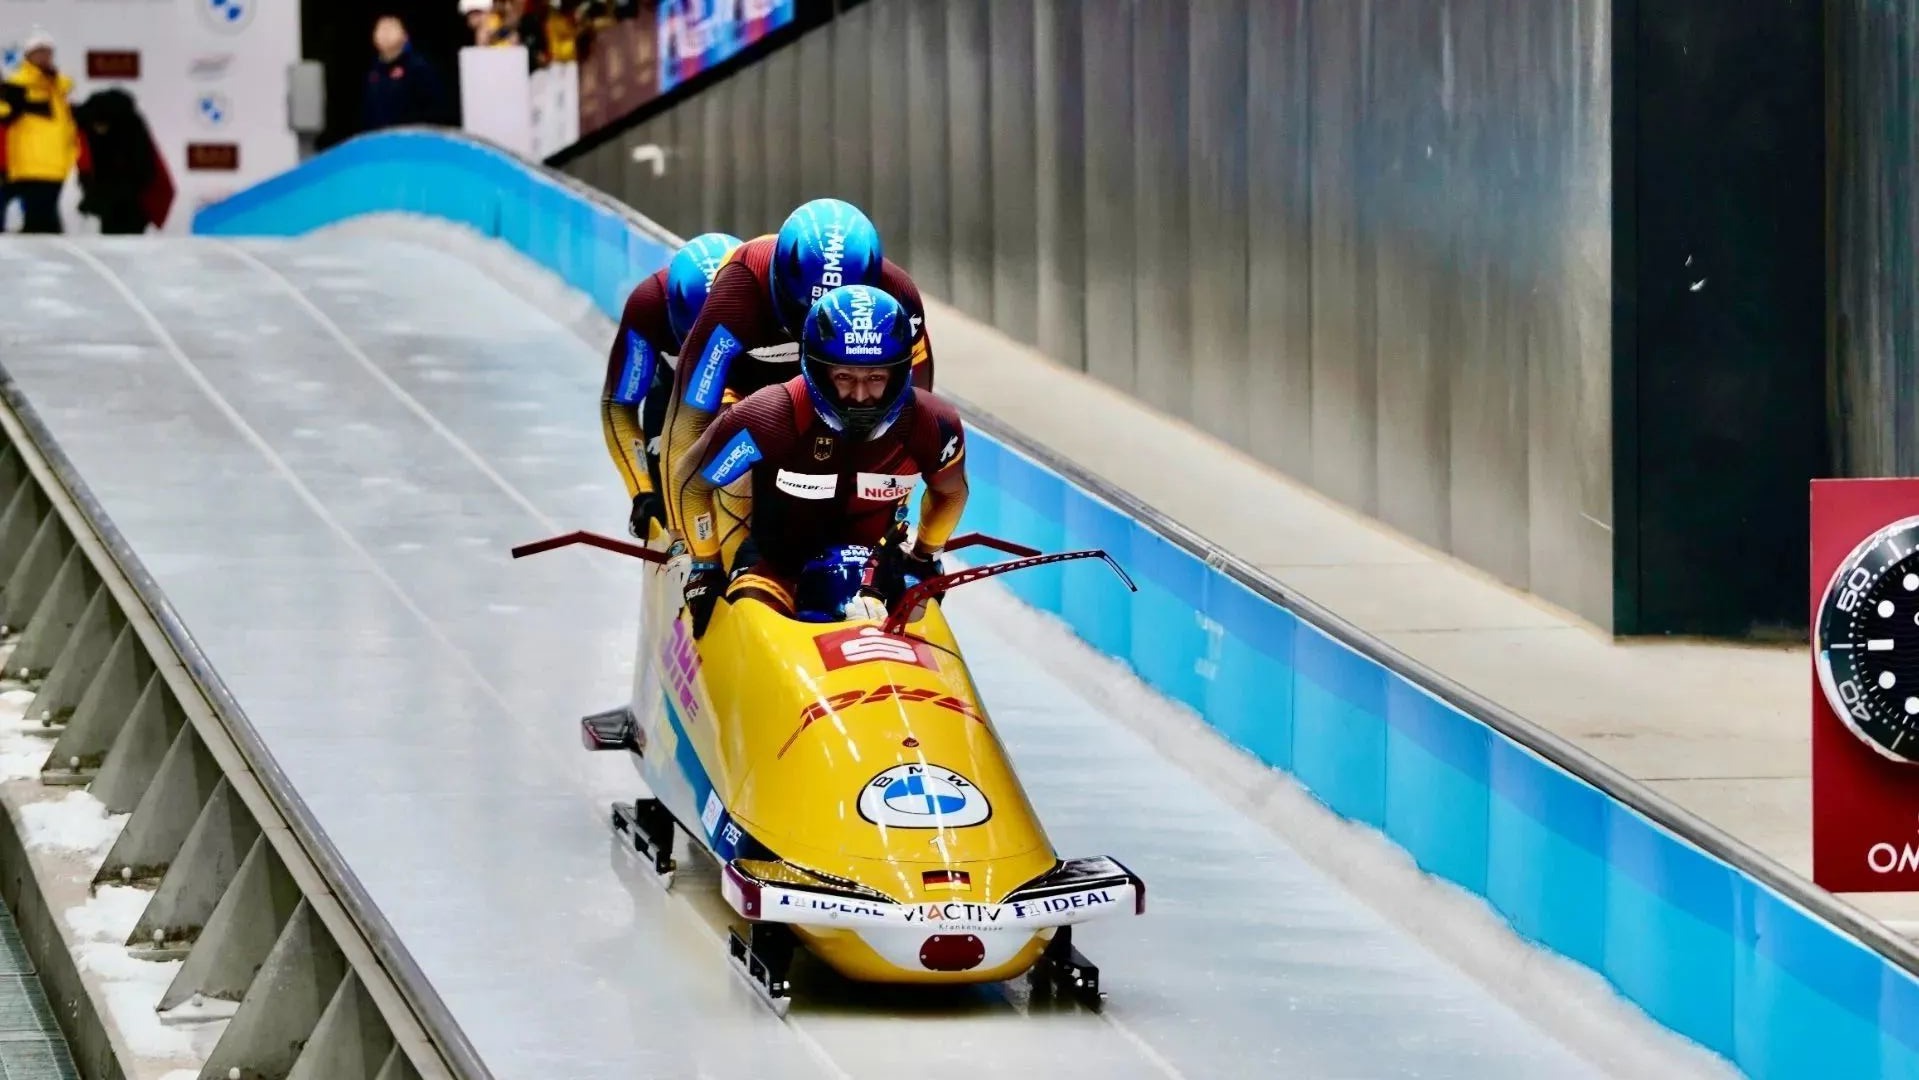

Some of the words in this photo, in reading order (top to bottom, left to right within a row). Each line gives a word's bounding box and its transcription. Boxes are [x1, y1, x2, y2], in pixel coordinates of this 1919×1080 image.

[844, 332, 882, 344] BMW
[846, 344, 882, 355] helmets
[1837, 567, 1869, 612] 50
[1839, 680, 1871, 722] 40
[872, 765, 971, 789] BMW
[721, 822, 743, 846] FES
[902, 903, 1002, 922] VIACTIV
[1044, 891, 1115, 914] IDEAL
